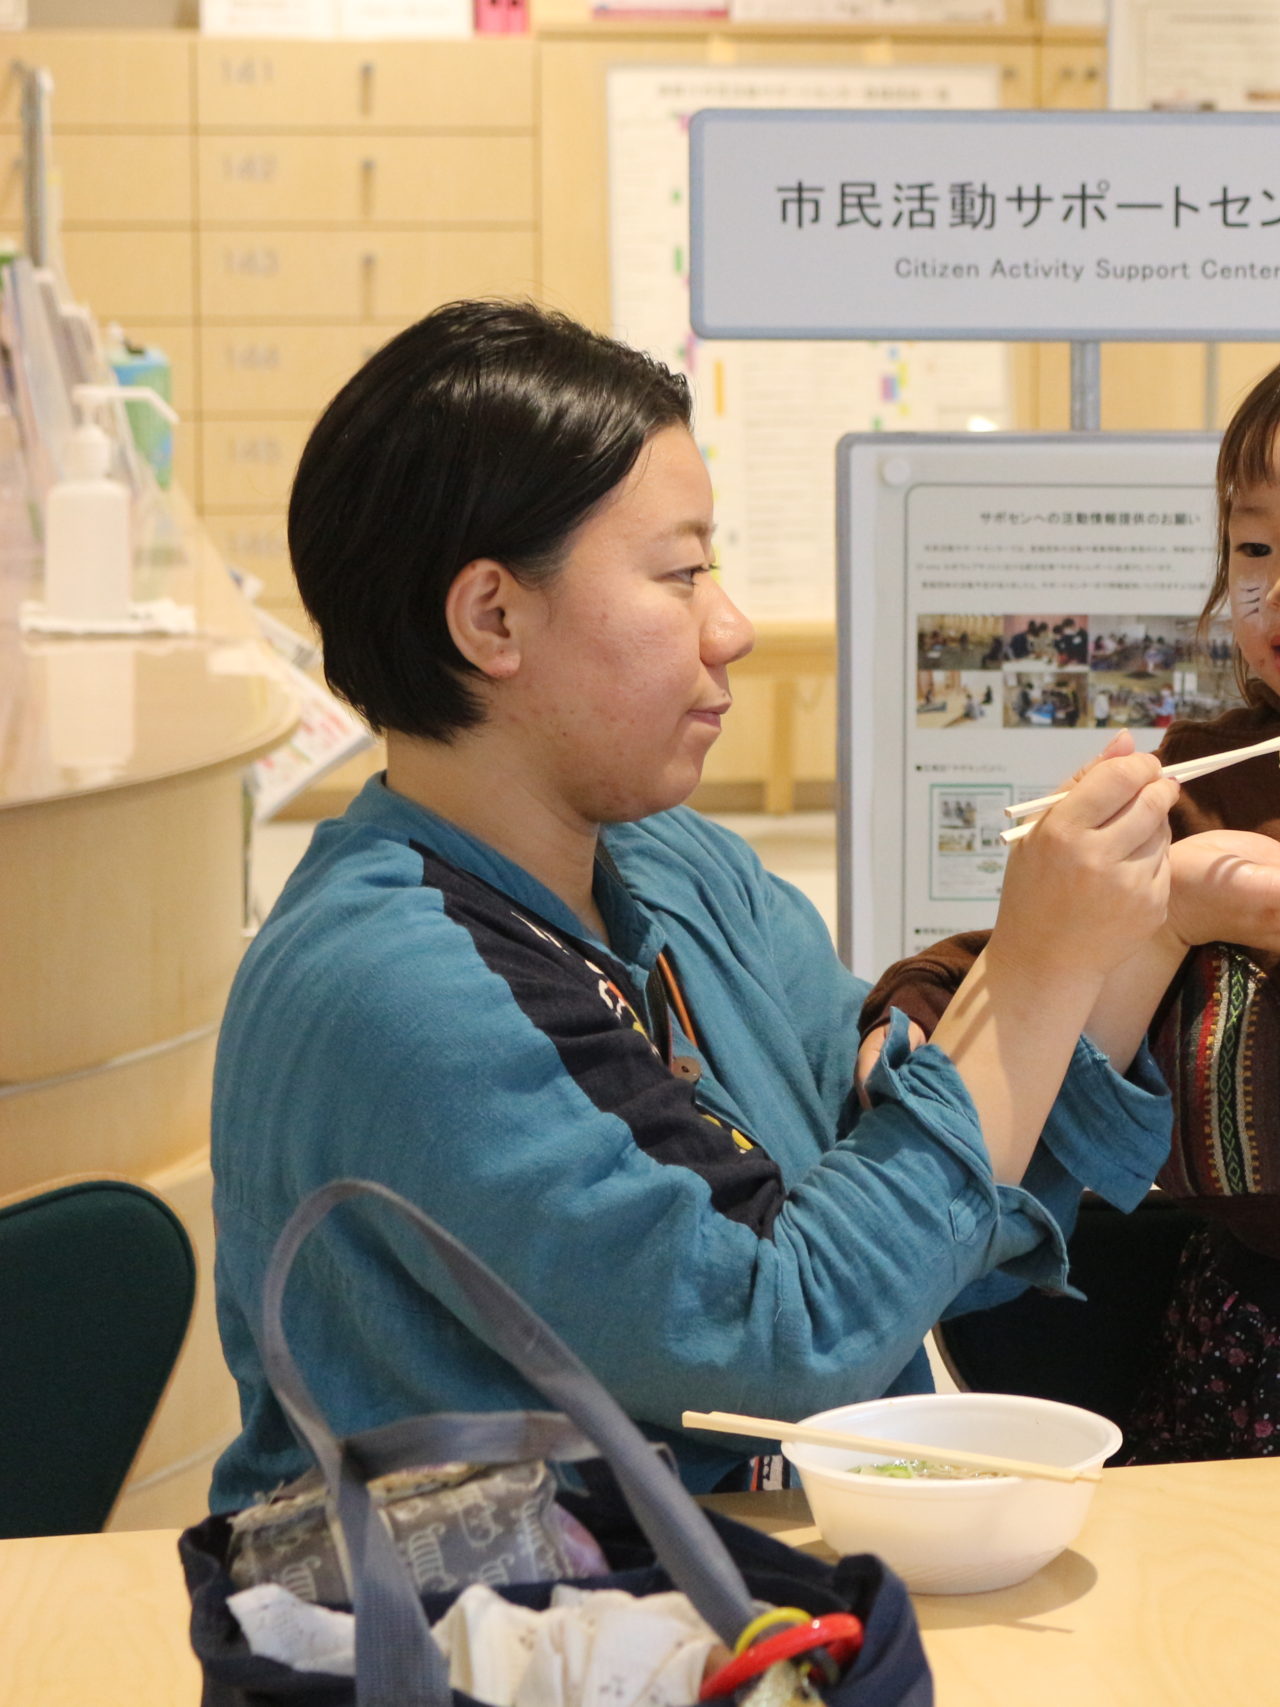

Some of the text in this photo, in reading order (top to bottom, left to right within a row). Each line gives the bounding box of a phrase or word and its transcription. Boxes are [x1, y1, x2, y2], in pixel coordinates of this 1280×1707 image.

[893, 256, 980, 280] Citizen
[989, 256, 1085, 283] Activity
[1095, 256, 1190, 283] Support
[979, 511, 1201, 526] サポセンへの活動情報提供のお願い
